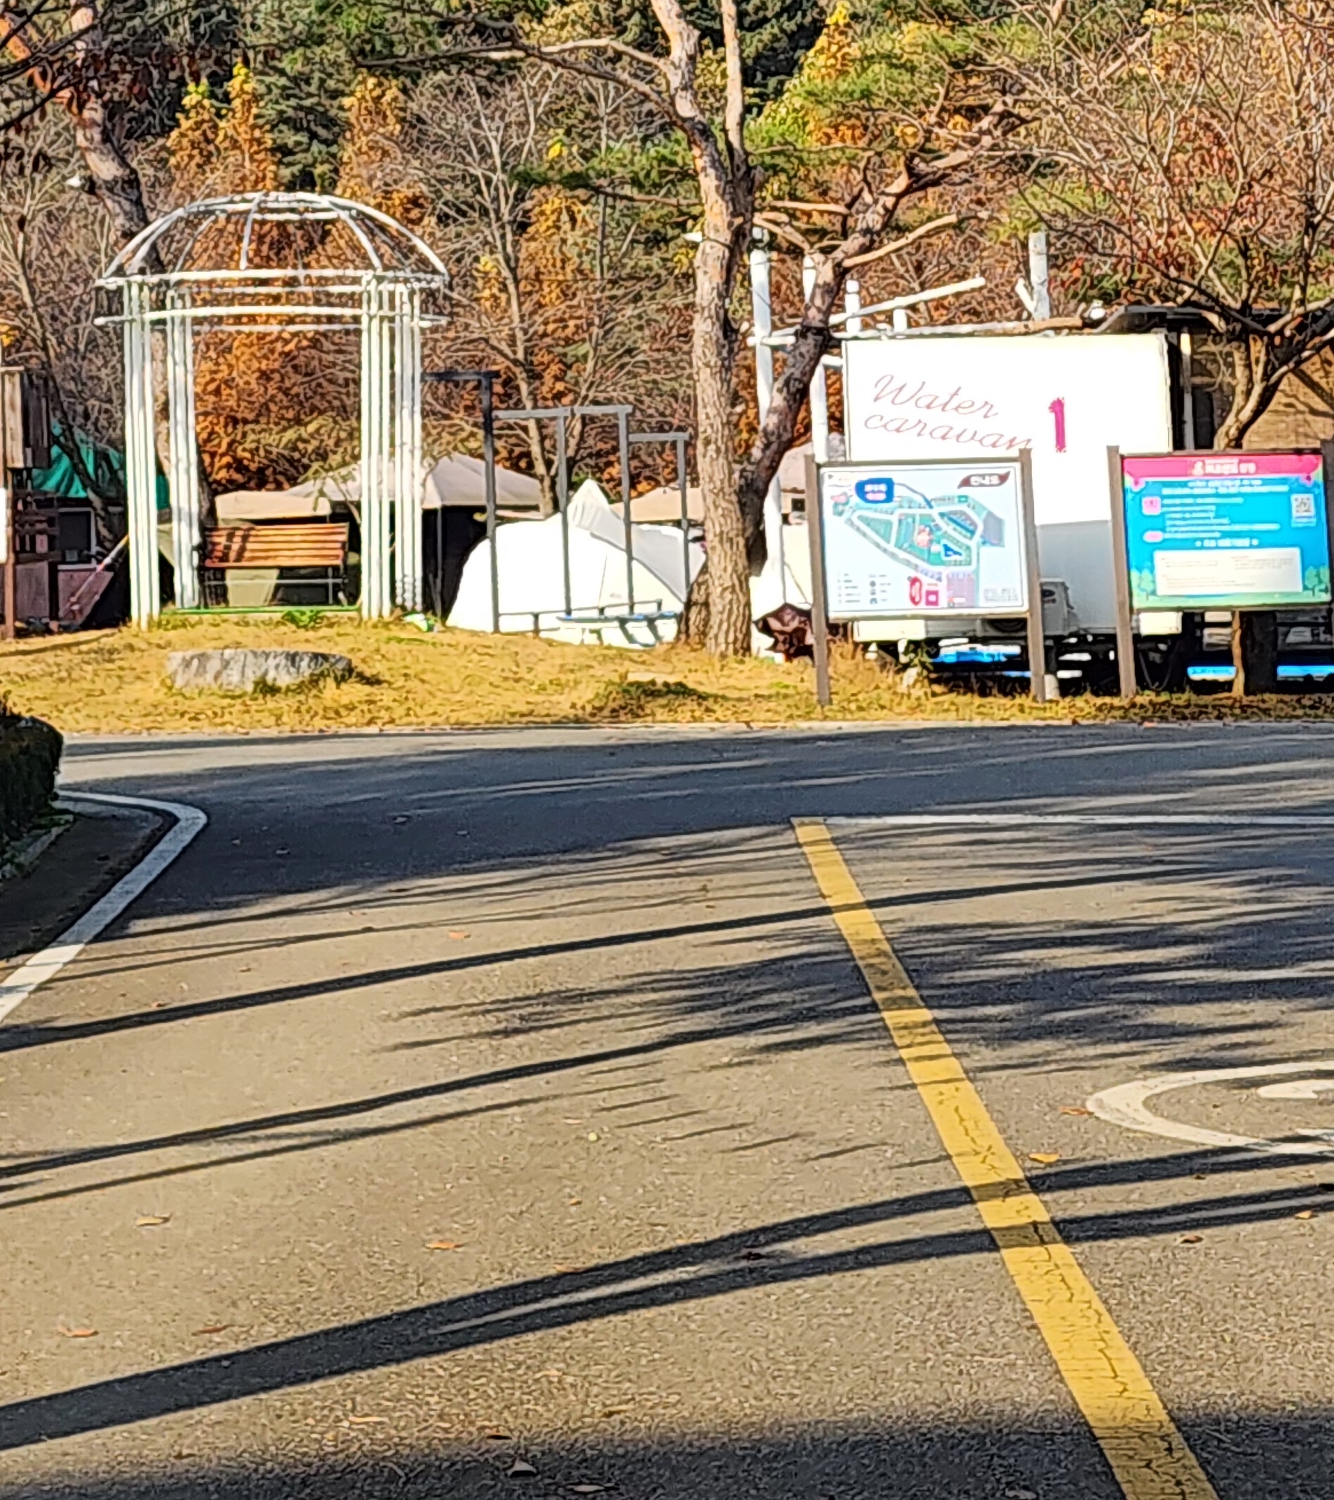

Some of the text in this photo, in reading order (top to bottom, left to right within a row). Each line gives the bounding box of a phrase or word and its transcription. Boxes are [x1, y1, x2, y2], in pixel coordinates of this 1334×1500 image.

[874, 373, 999, 420] Water
[864, 414, 1033, 452] caravan
[1048, 397, 1066, 453] 1
